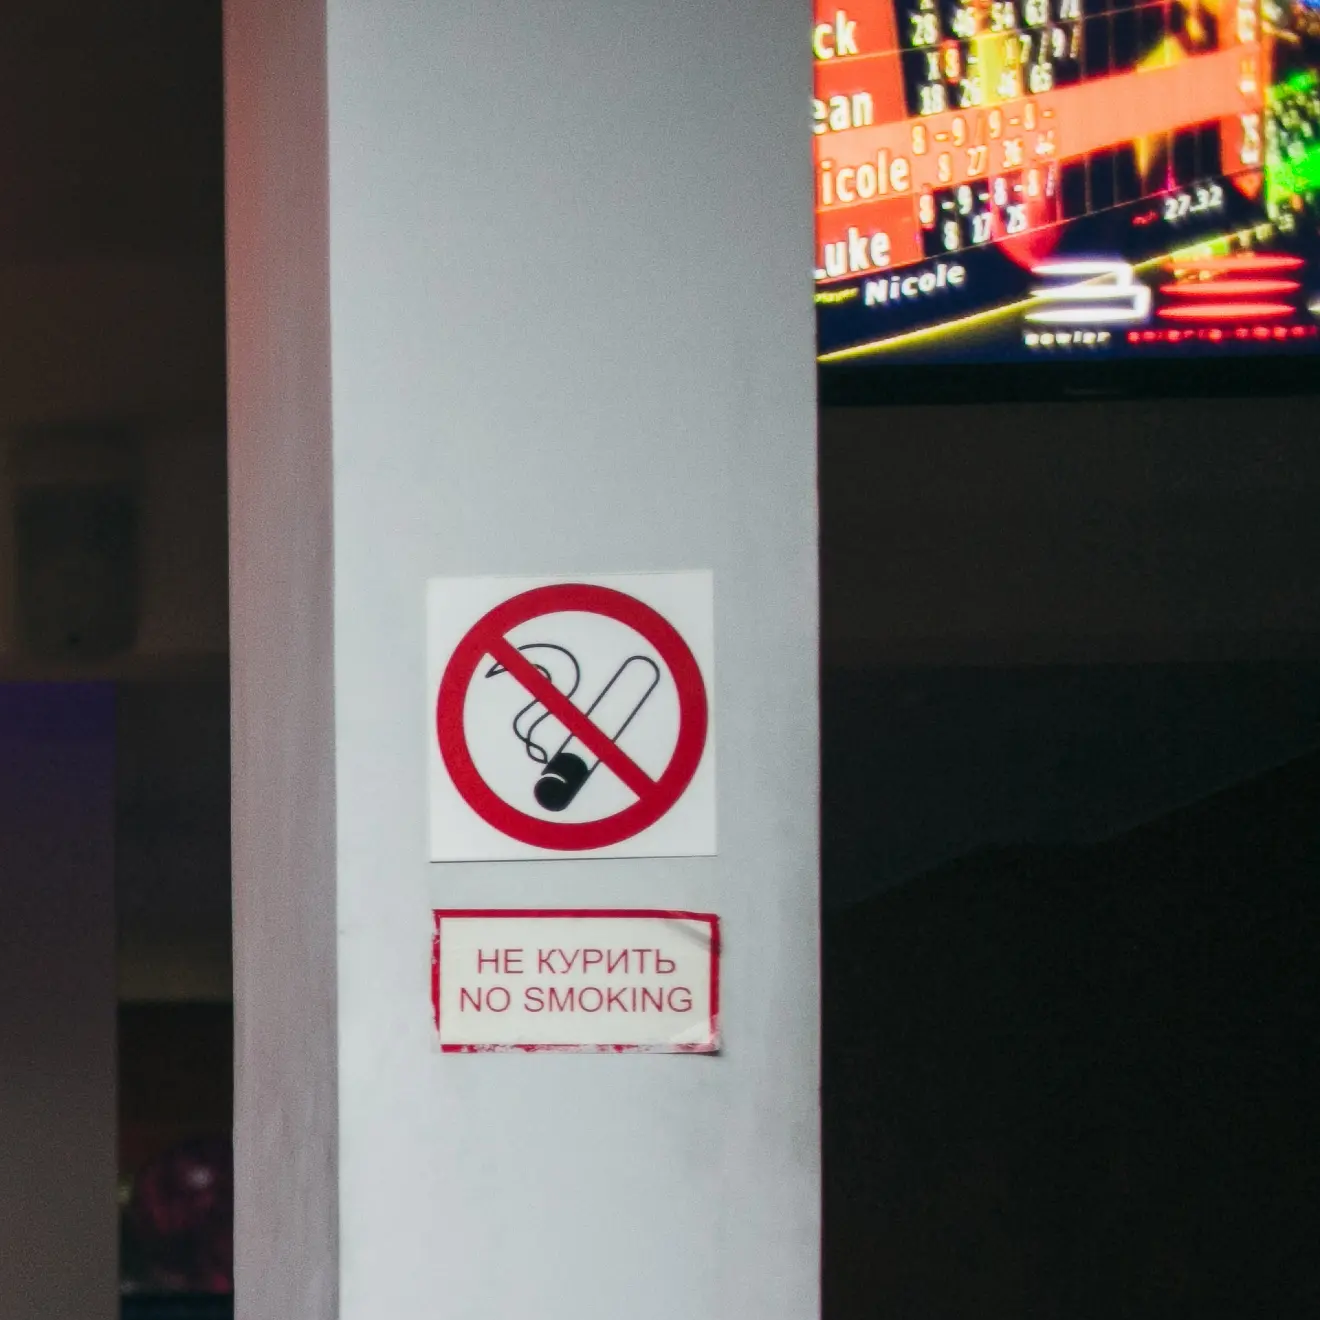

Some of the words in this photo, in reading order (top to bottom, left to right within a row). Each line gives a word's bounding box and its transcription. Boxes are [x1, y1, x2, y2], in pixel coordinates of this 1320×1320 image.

[821, 150, 910, 206] icole
[864, 262, 966, 306] Nicole
[477, 948, 524, 974] НЕ
[537, 948, 677, 975] КУРИТЬ
[460, 986, 511, 1012] NO
[524, 986, 693, 1013] SMOKING
